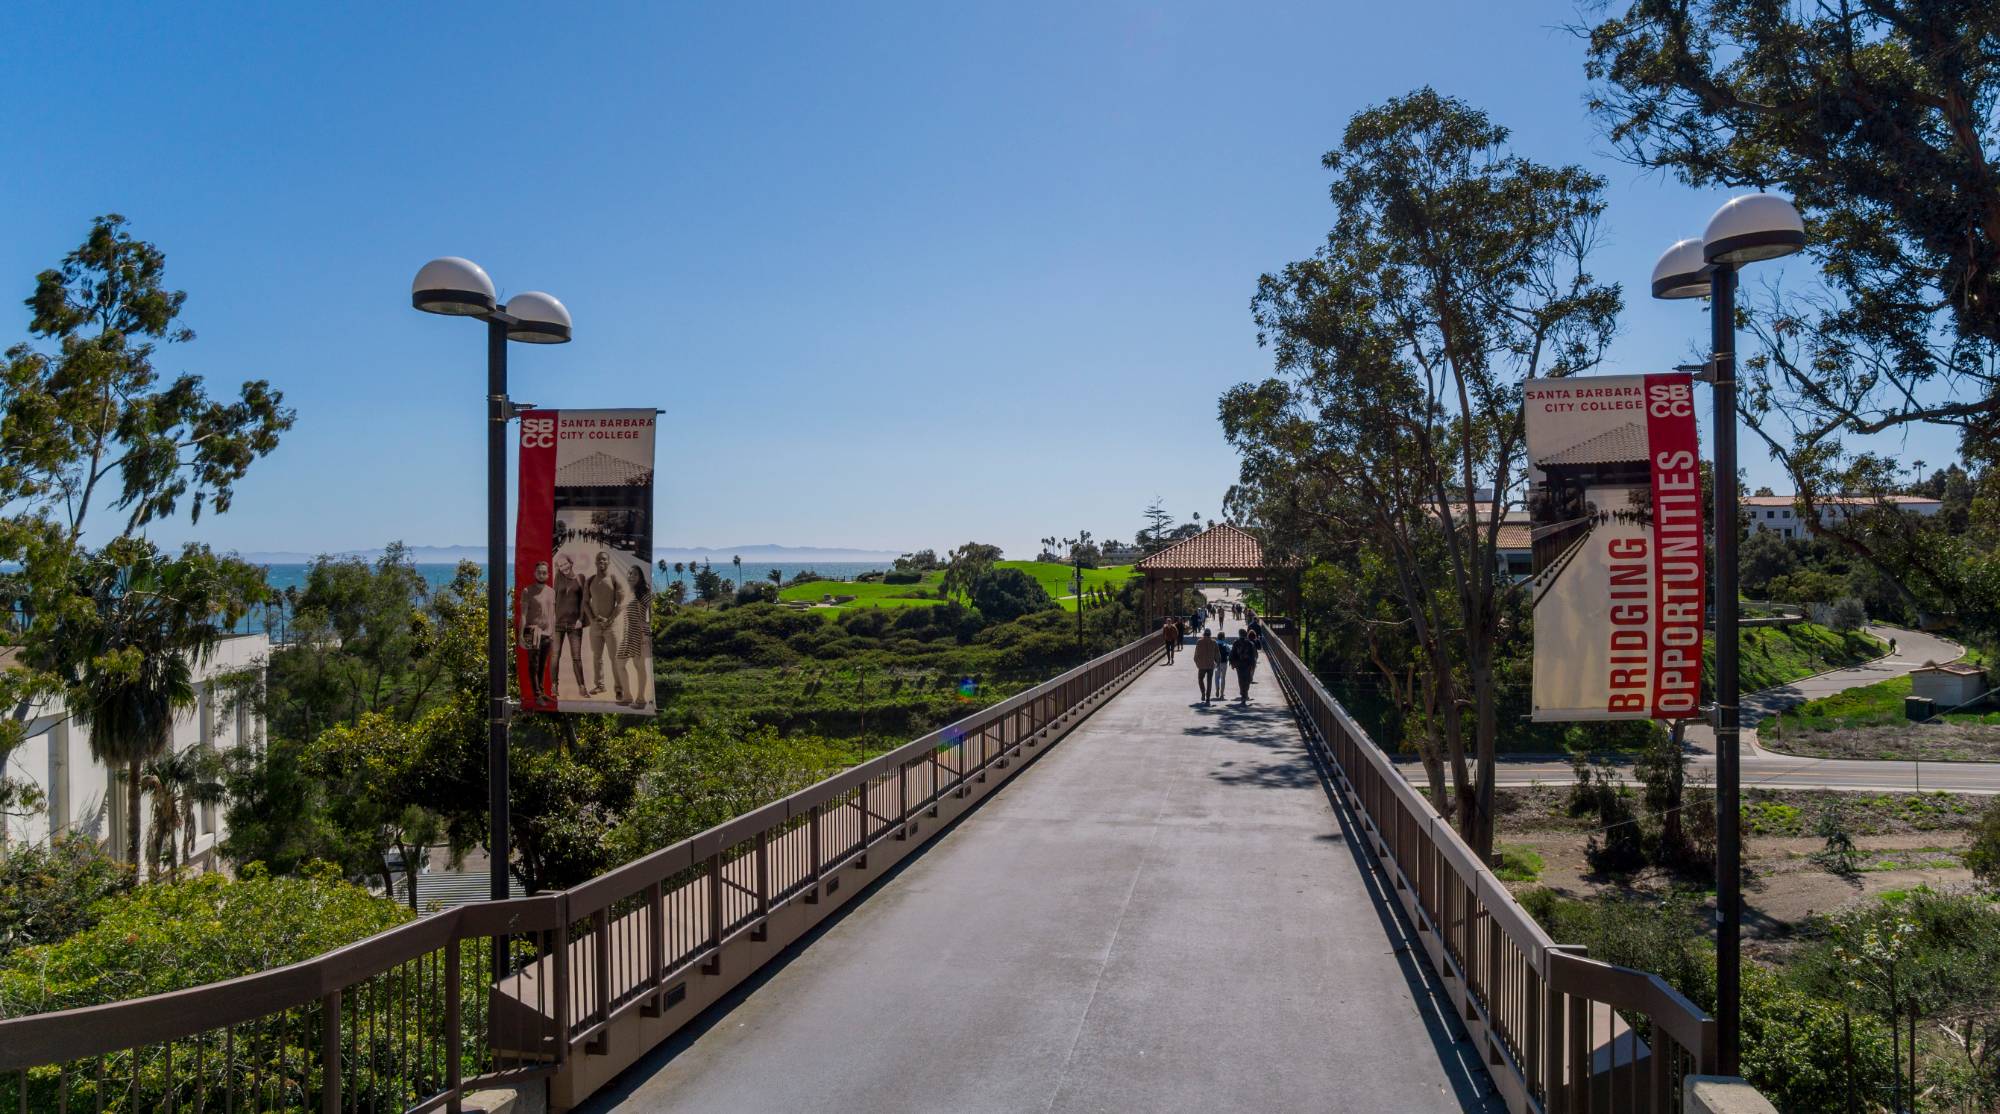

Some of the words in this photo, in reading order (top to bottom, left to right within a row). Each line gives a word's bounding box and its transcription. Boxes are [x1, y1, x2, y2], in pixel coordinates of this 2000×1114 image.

[1527, 389, 1571, 400] SANTA
[1576, 387, 1642, 398] BARBARA
[1649, 384, 1690, 401] SB
[1544, 402, 1575, 413] CITY
[1580, 400, 1644, 412] COLLEGE
[1649, 401, 1692, 418] CC
[522, 418, 555, 433] SB
[560, 419, 596, 428] SANTA
[600, 418, 654, 428] BARBARA
[521, 433, 554, 448] CC
[560, 431, 585, 440] CITY
[588, 430, 640, 440] COLLEGE
[1656, 450, 1699, 712] OPPORTUNITIES
[1608, 538, 1648, 713] BRIDGING
